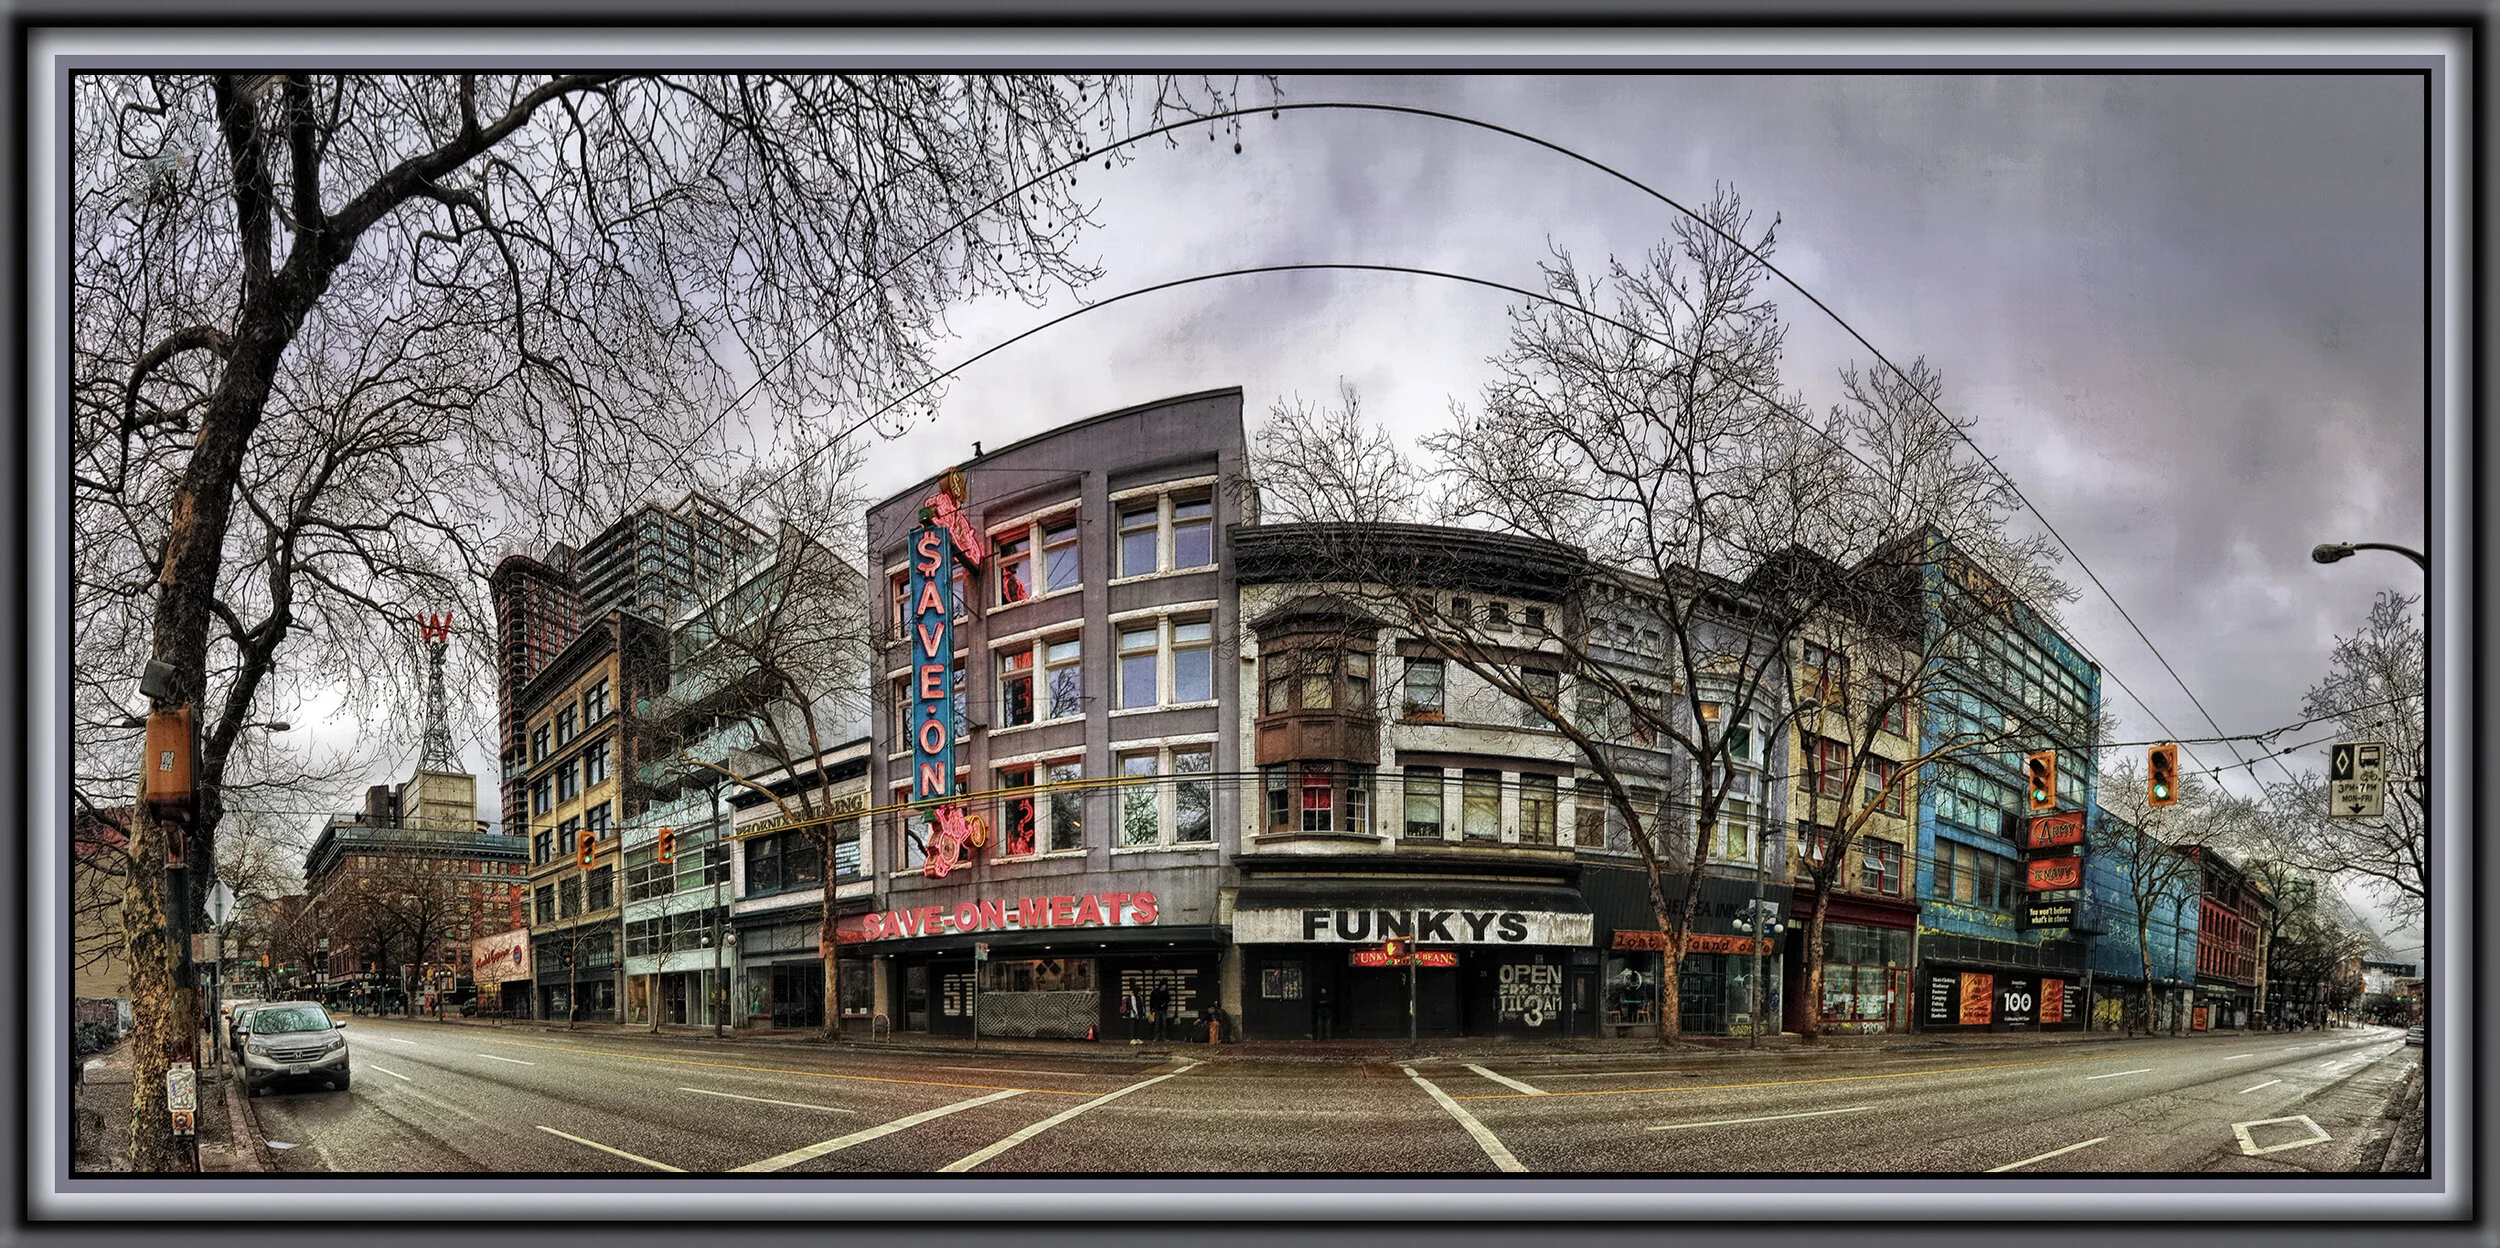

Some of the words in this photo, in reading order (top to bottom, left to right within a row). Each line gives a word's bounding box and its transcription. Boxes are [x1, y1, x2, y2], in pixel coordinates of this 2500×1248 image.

[418, 611, 452, 643] W
[2038, 820, 2076, 845] ARMY
[2043, 866, 2072, 880] NAVY
[862, 892, 1158, 940] SAVE-ON-MEATS
[1302, 910, 1528, 941] FUNKYS
[1618, 934, 1655, 948] lost
[1422, 953, 1457, 965] BEANS
[1500, 965, 1562, 983] OPEN
[1524, 995, 1544, 1026] 3
[2004, 993, 2032, 1011] 100
